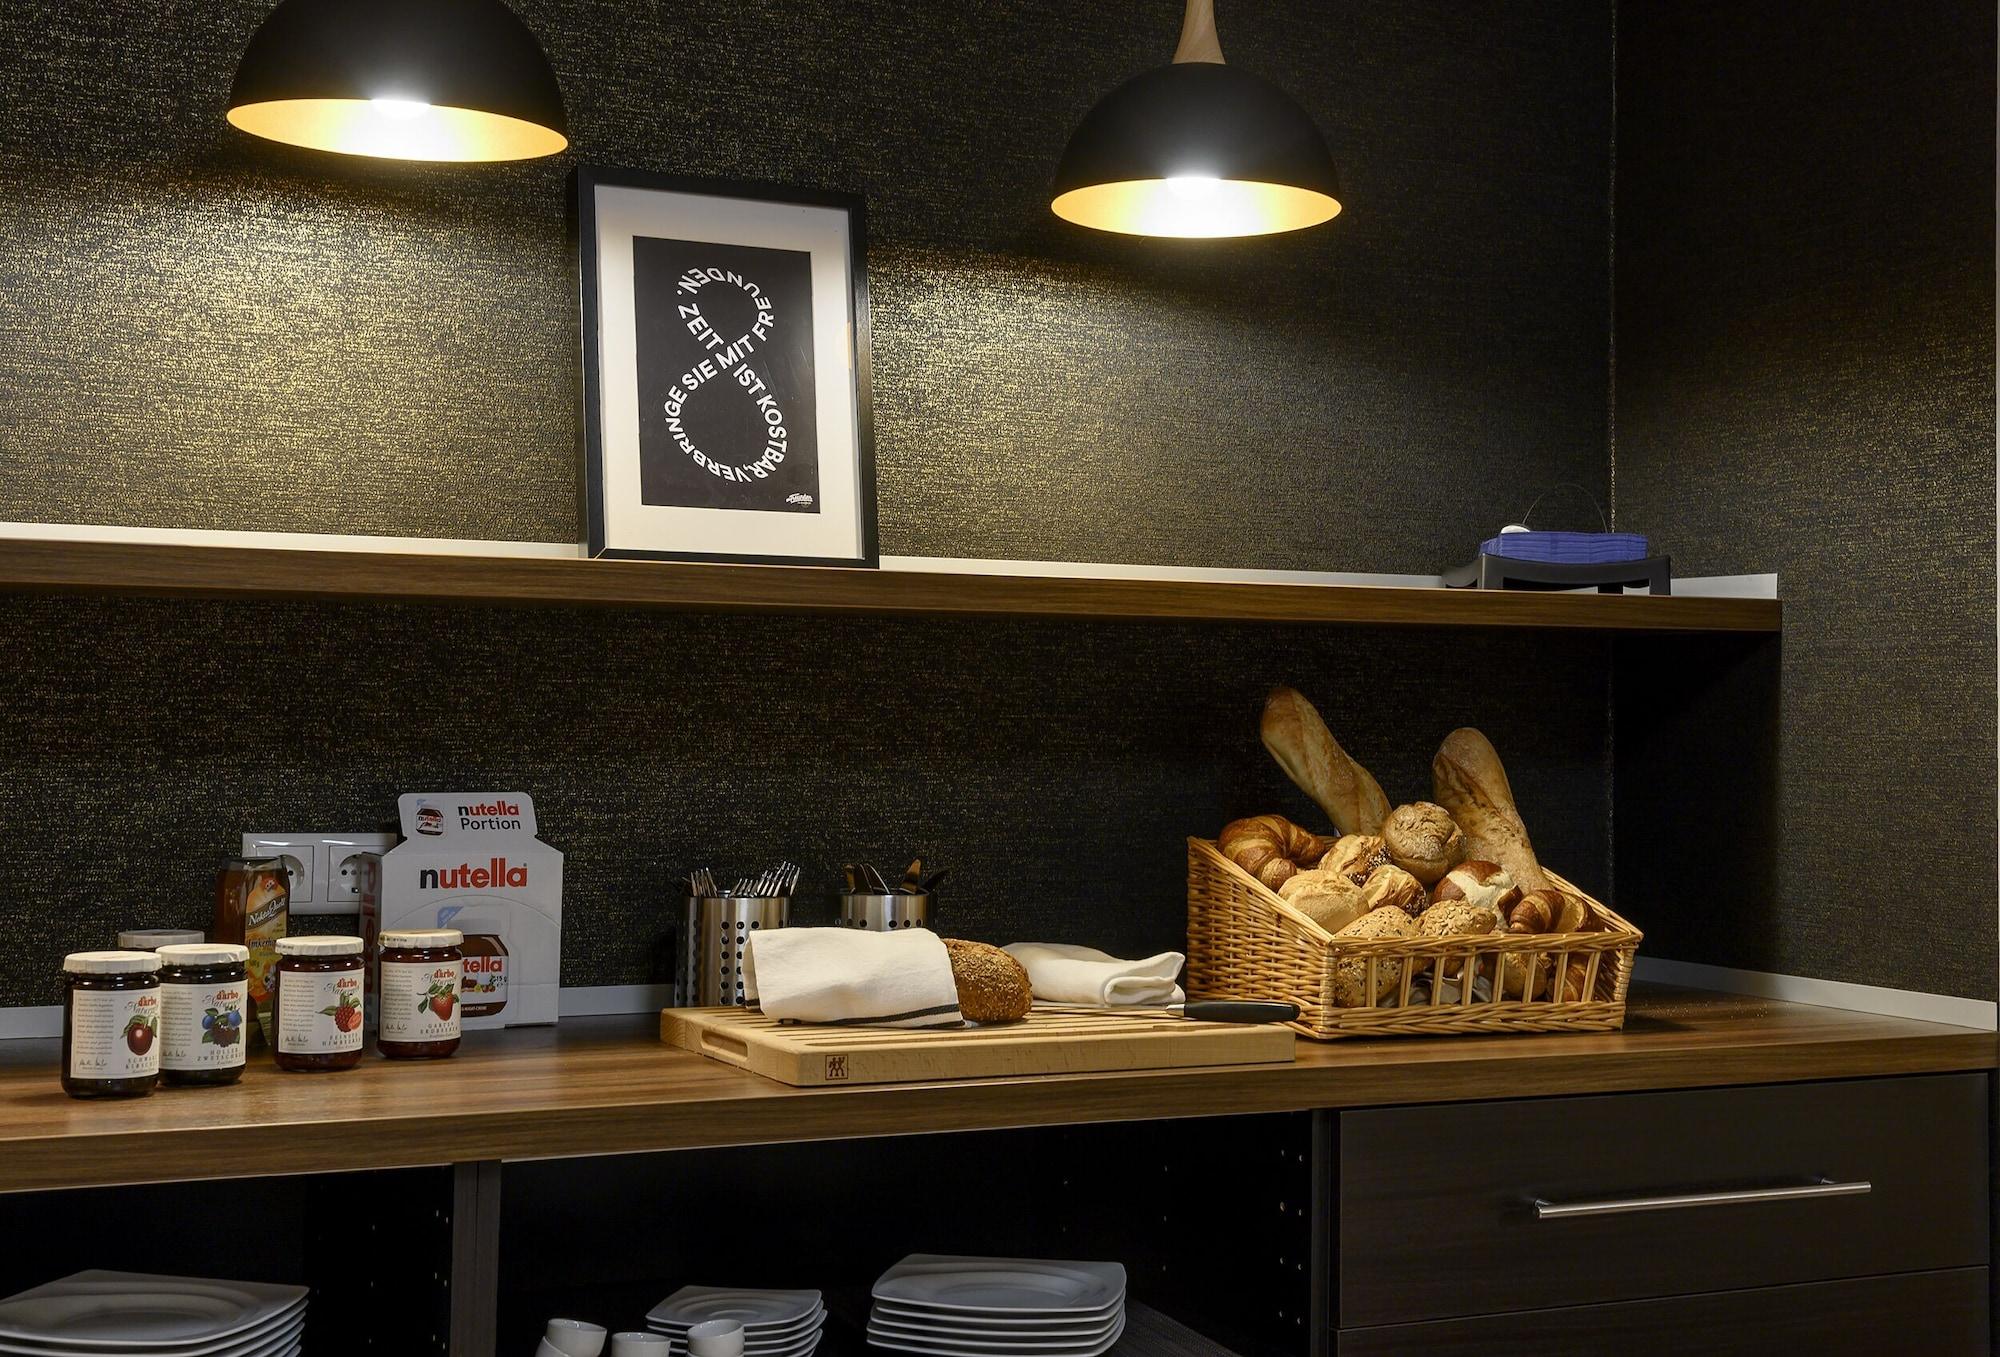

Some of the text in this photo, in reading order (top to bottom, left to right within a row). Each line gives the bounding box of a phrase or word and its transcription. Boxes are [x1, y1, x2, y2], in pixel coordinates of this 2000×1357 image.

[676, 267, 775, 343] FREUNDEN.
[677, 302, 725, 351] ZEIT
[714, 333, 756, 370] MIT
[681, 358, 719, 391] SIE
[732, 362, 767, 396] IST
[664, 385, 753, 483] VERBRINGE
[458, 800, 520, 817] nutella
[461, 817, 521, 831] Portion
[420, 857, 528, 889] nutella
[463, 955, 503, 973] tella
